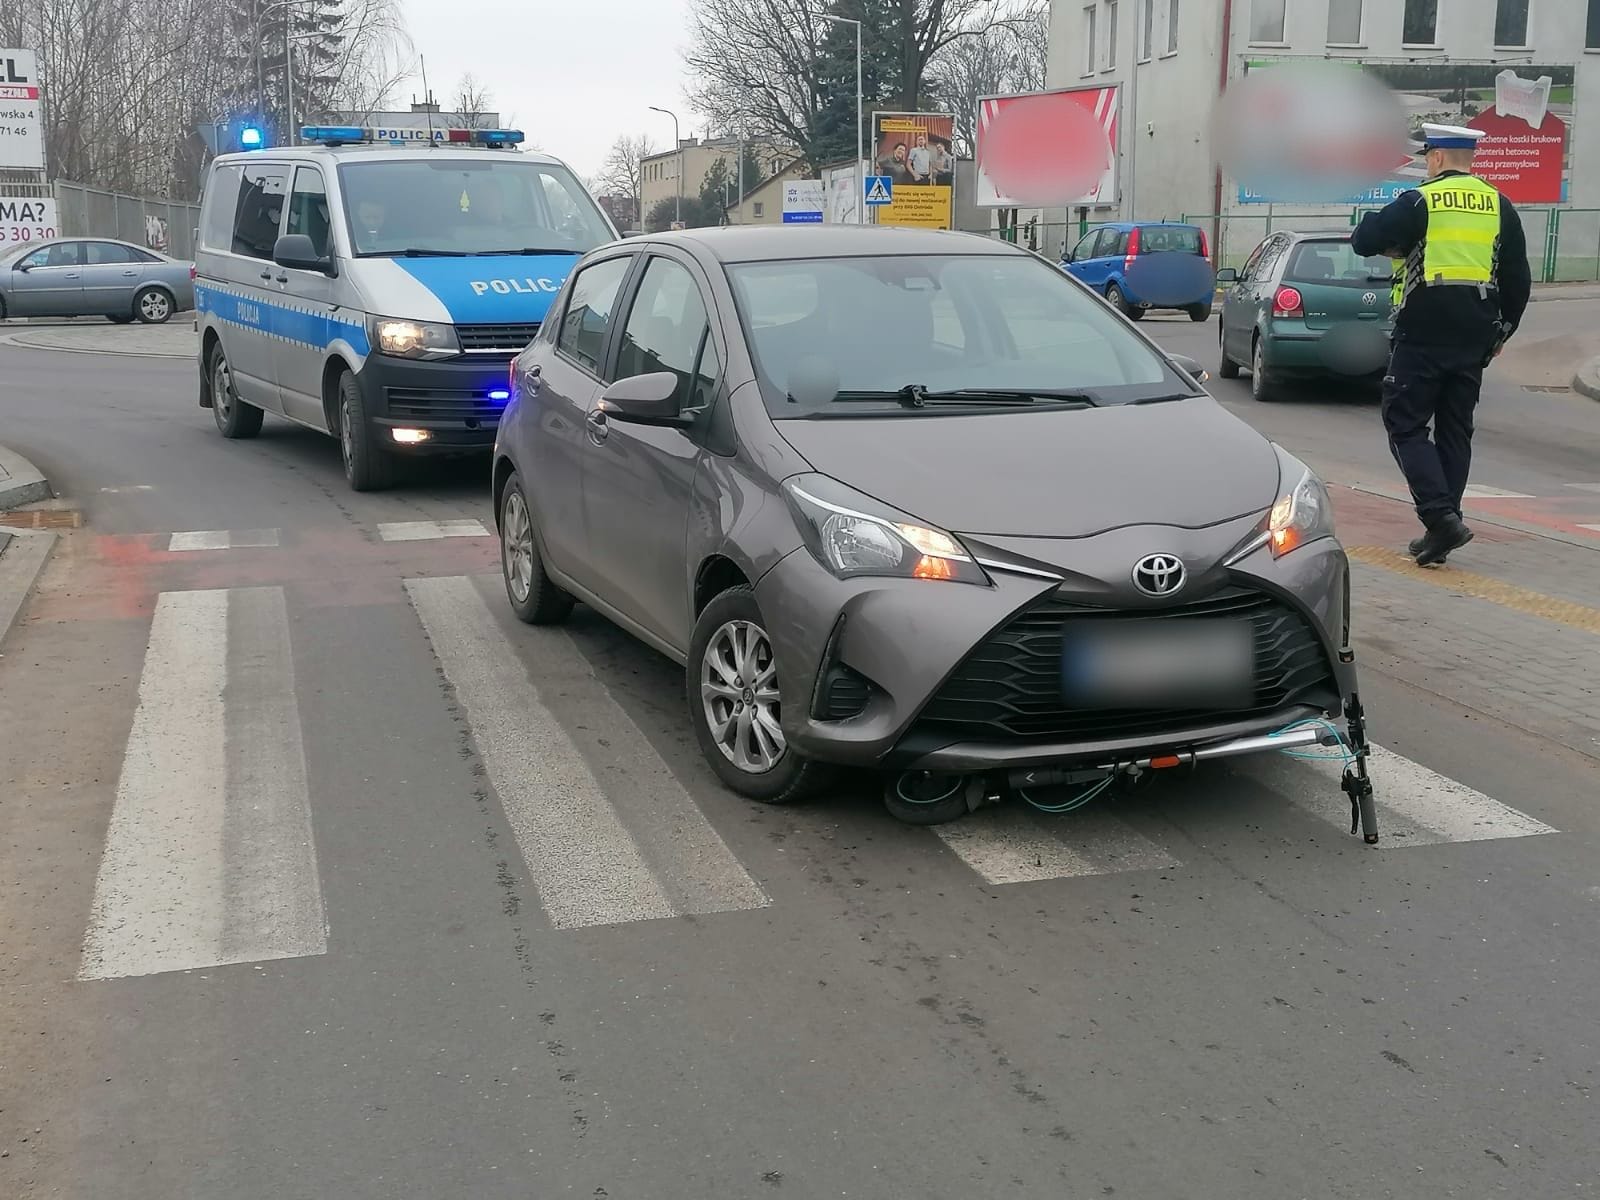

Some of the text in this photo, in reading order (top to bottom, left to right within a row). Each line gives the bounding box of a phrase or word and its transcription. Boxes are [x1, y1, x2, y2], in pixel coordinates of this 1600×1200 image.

[0, 59, 28, 83] L
[27, 110, 34, 119] 4
[14, 127, 27, 136] 46
[1531, 135, 1562, 144] brukowe
[1505, 147, 1540, 156] betonowa
[1488, 173, 1520, 181] tarasowe
[1368, 187, 1389, 199] TEL.
[1430, 191, 1495, 212] POLICJA
[0, 202, 45, 222] MA?
[10, 226, 31, 241] 30
[36, 227, 55, 239] 30
